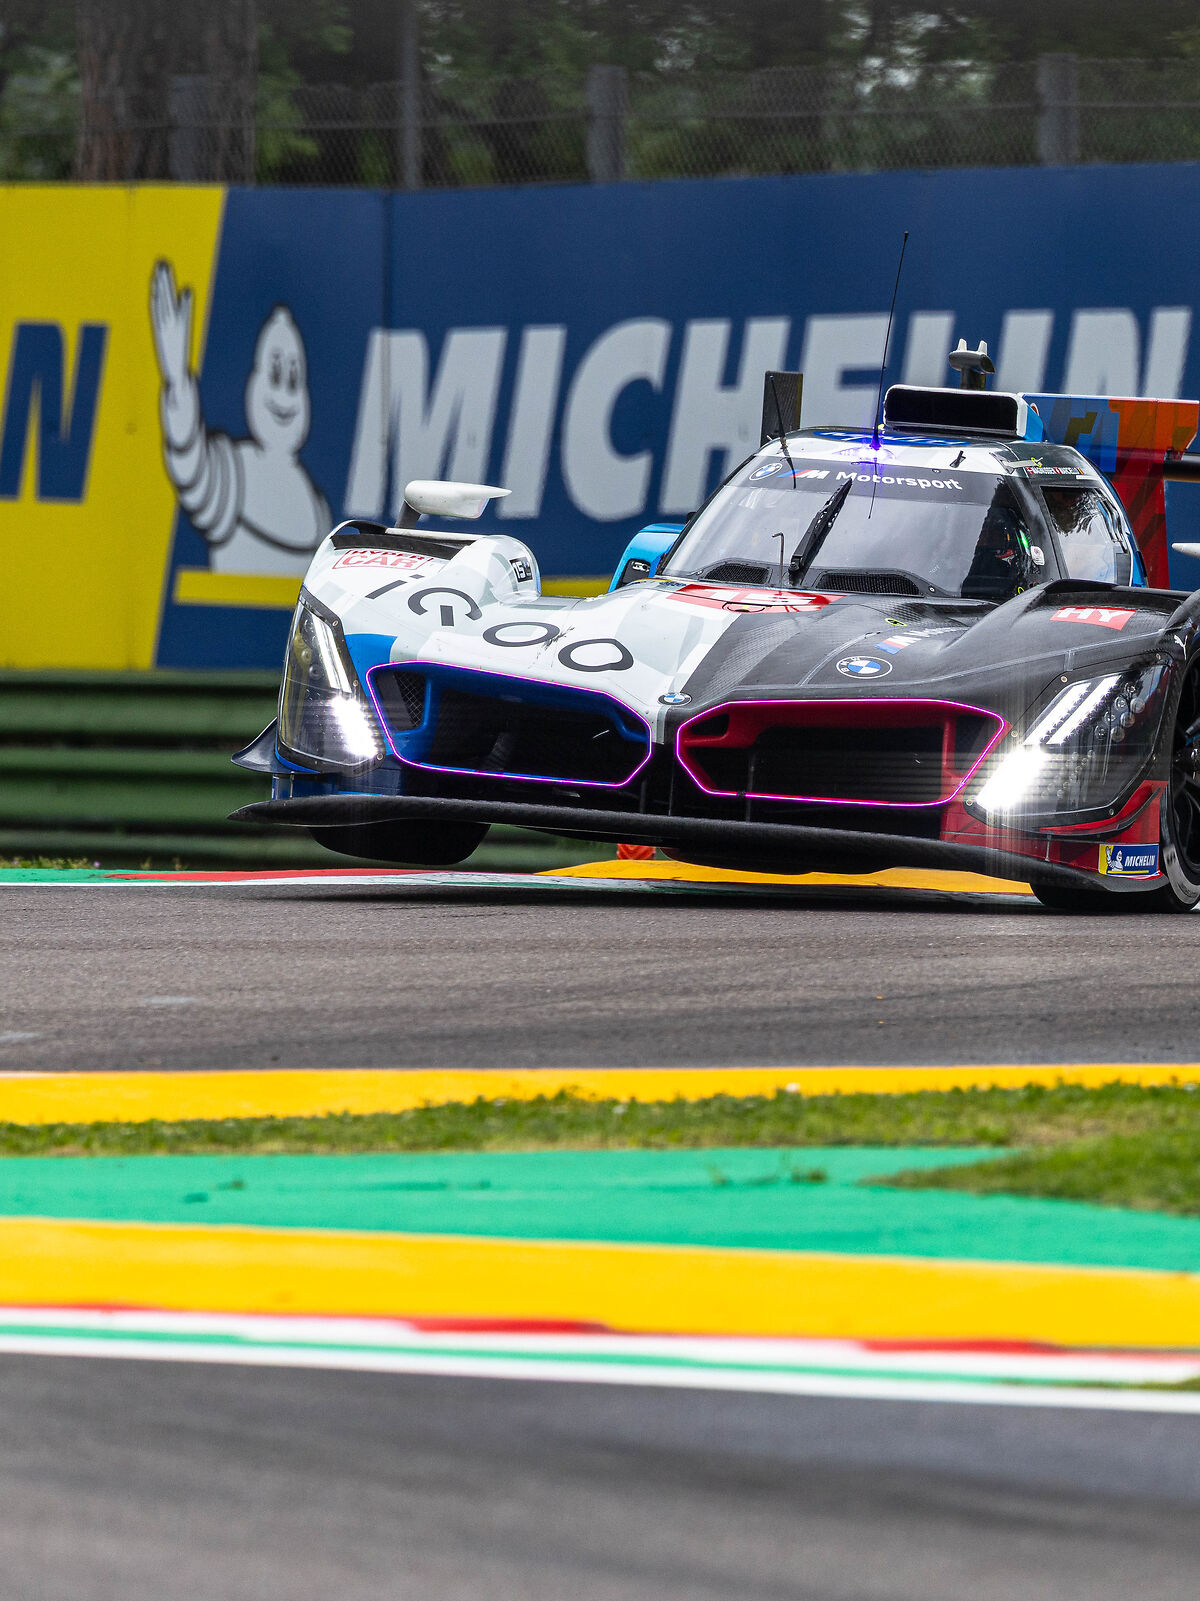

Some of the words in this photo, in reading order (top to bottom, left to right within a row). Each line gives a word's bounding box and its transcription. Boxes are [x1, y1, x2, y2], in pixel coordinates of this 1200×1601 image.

[835, 471, 963, 491] Motorsport
[342, 555, 418, 568] CAR
[1056, 607, 1129, 622] HY
[1124, 855, 1156, 867] MICHELIN
